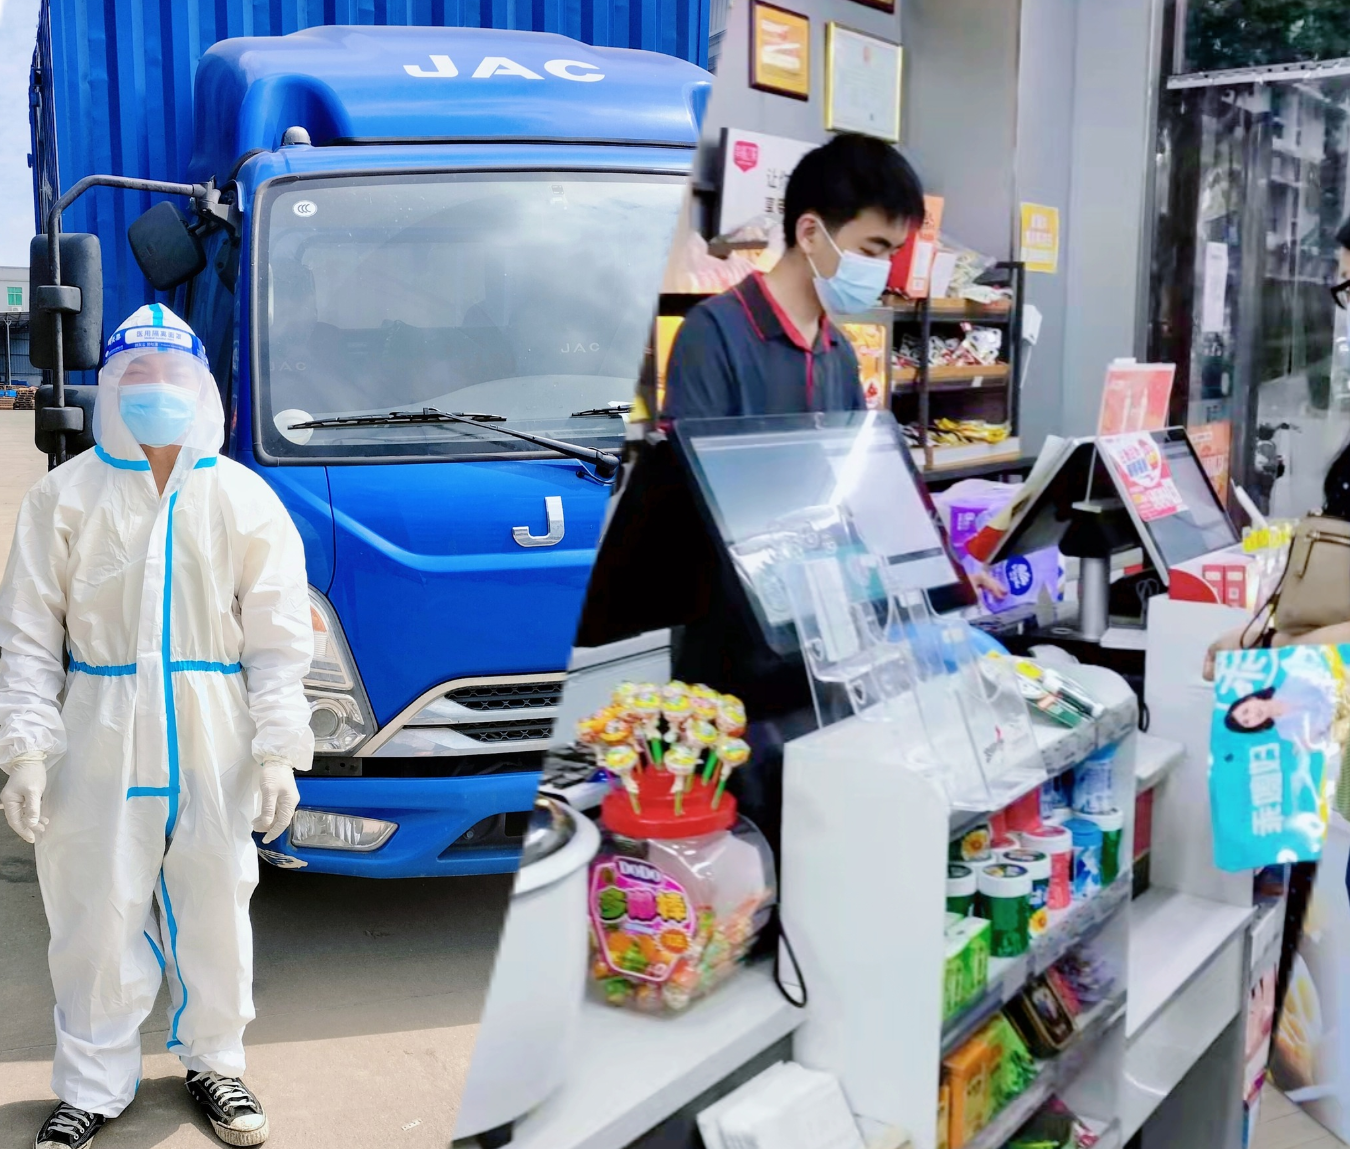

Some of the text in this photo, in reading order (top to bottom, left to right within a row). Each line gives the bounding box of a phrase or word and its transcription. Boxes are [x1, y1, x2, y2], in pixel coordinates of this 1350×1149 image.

[403, 55, 605, 82] JAC
[136, 330, 182, 340] 医用隔离面罩
[561, 342, 600, 353] JAC
[512, 496, 565, 548] J
